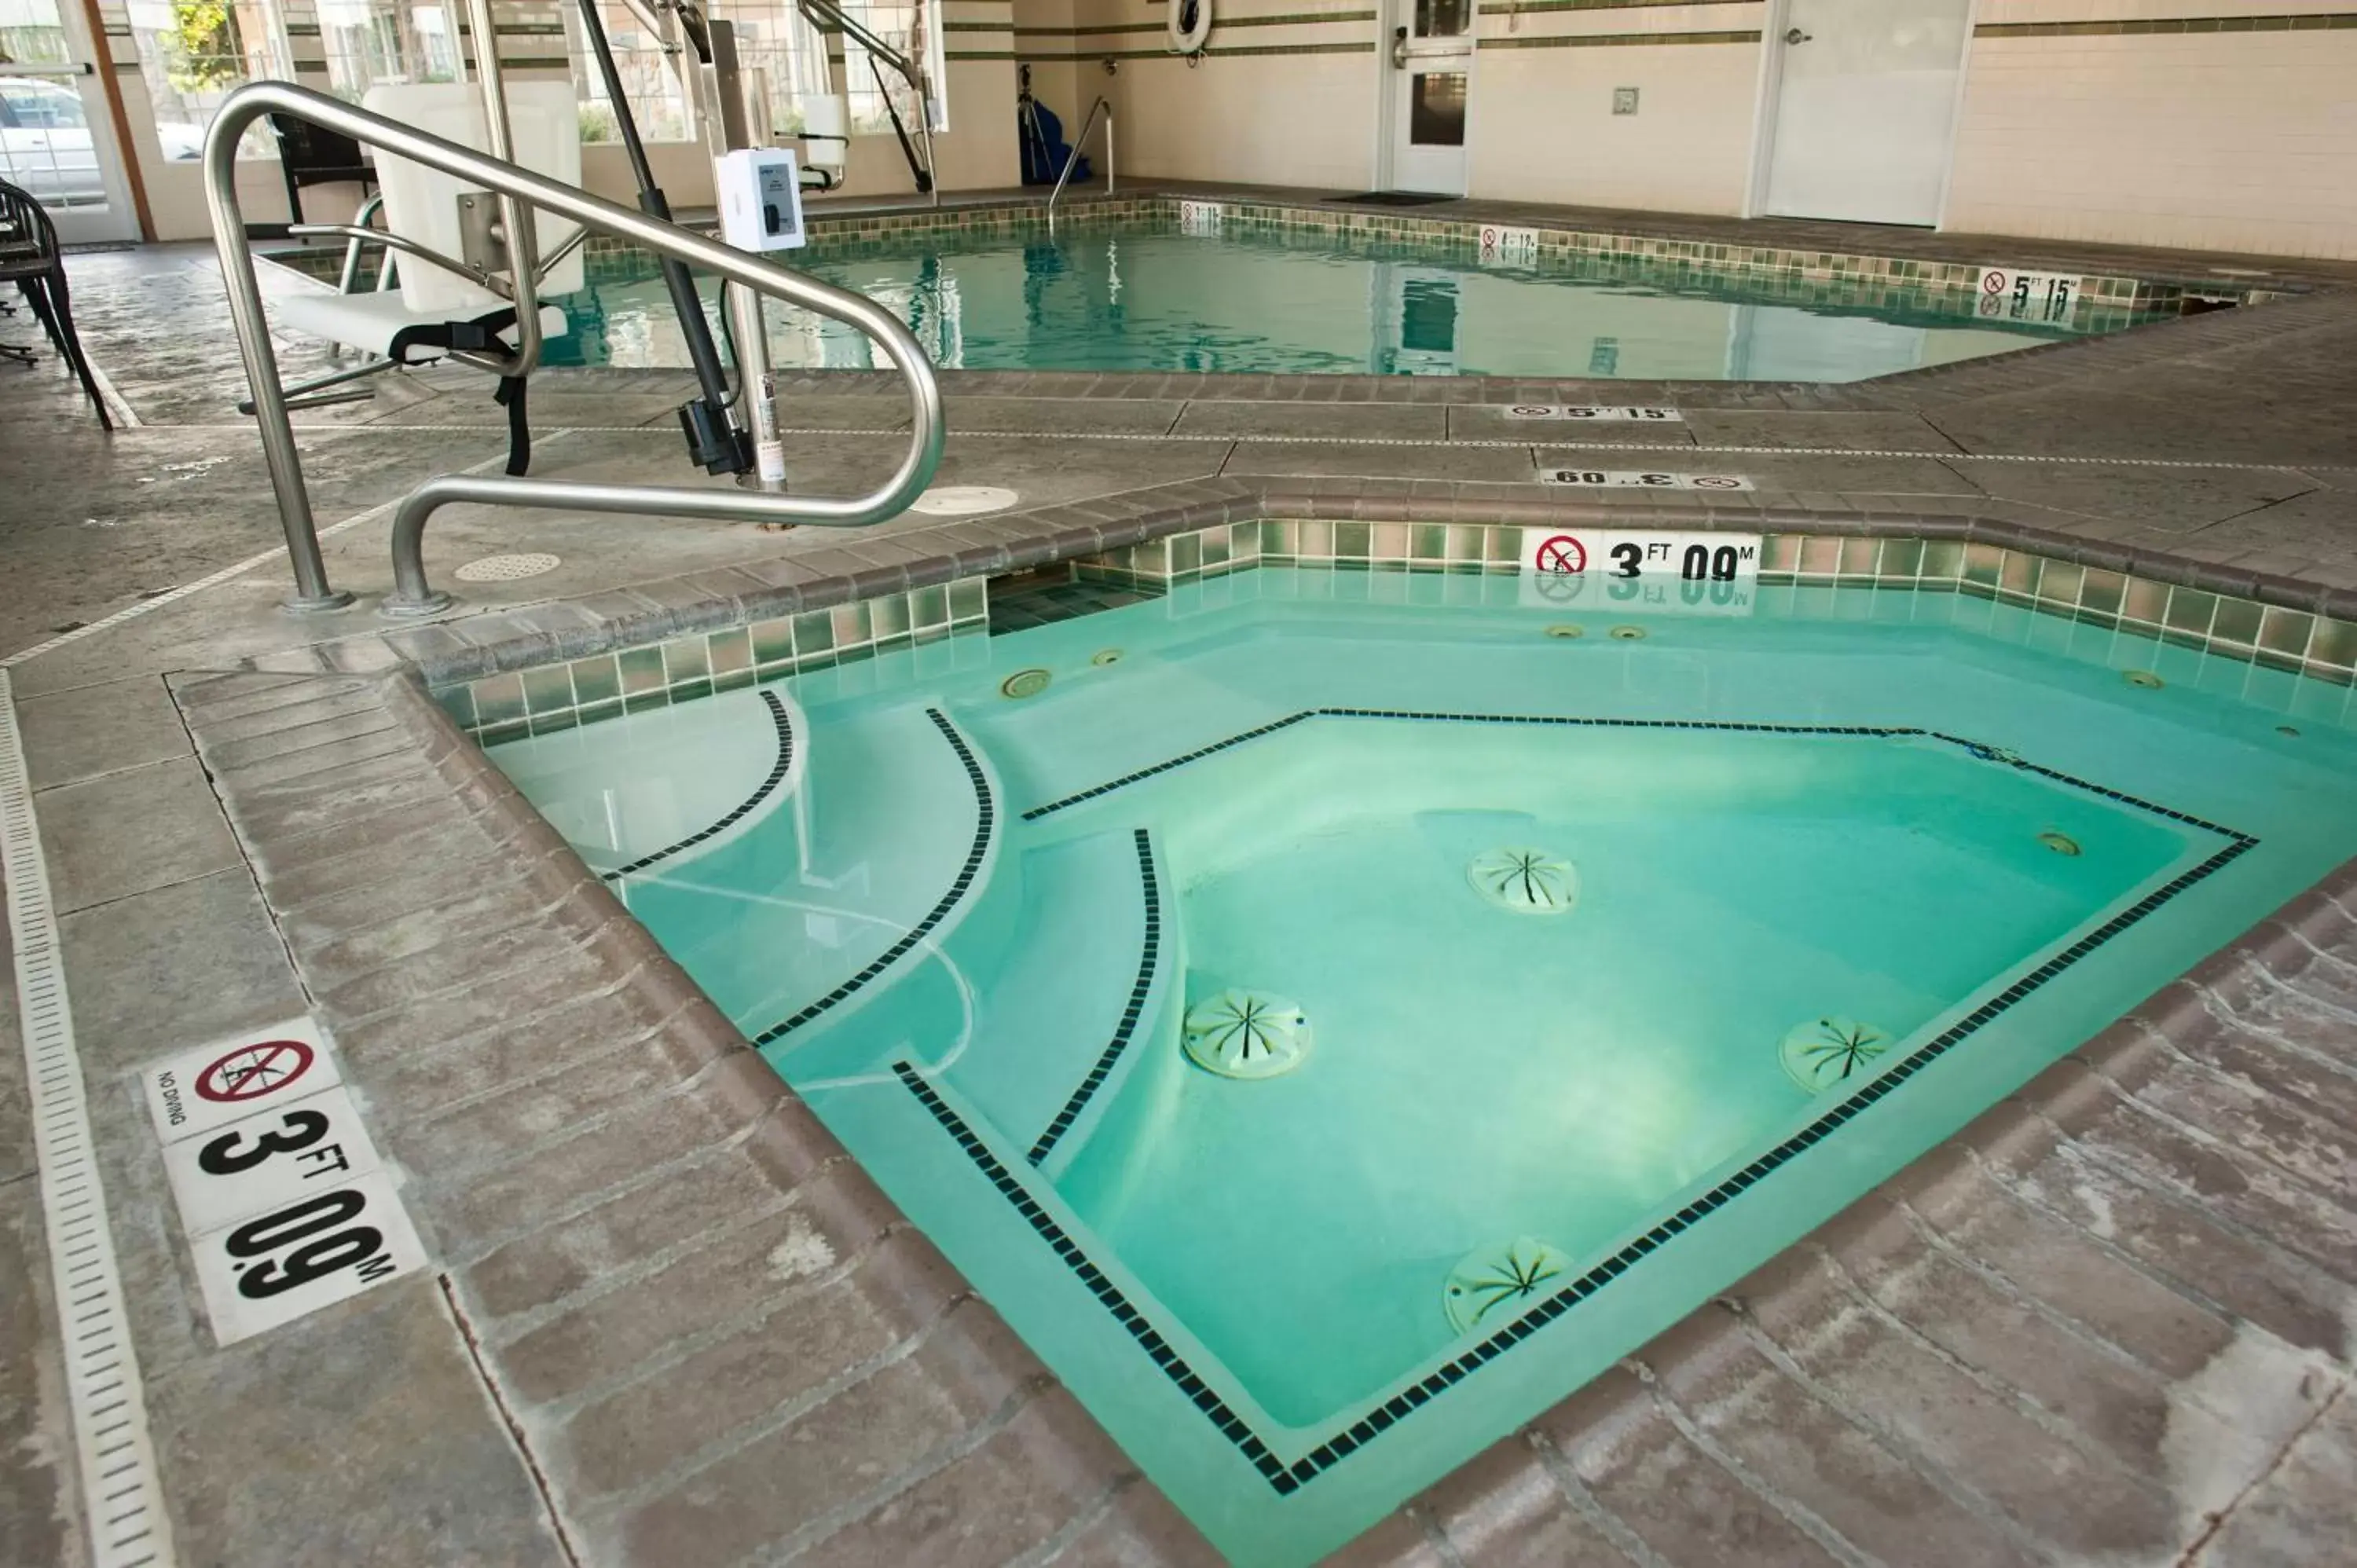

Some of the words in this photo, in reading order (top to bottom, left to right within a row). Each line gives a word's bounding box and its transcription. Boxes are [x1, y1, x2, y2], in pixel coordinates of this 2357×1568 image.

[1609, 542, 1643, 578] 3
[1648, 544, 1672, 561] FT
[1739, 546, 1754, 560] M
[157, 1070, 176, 1088] NO
[163, 1087, 187, 1127] DIVING
[198, 1109, 330, 1176] 3
[295, 1143, 350, 1180] FT
[355, 1253, 398, 1284] M
